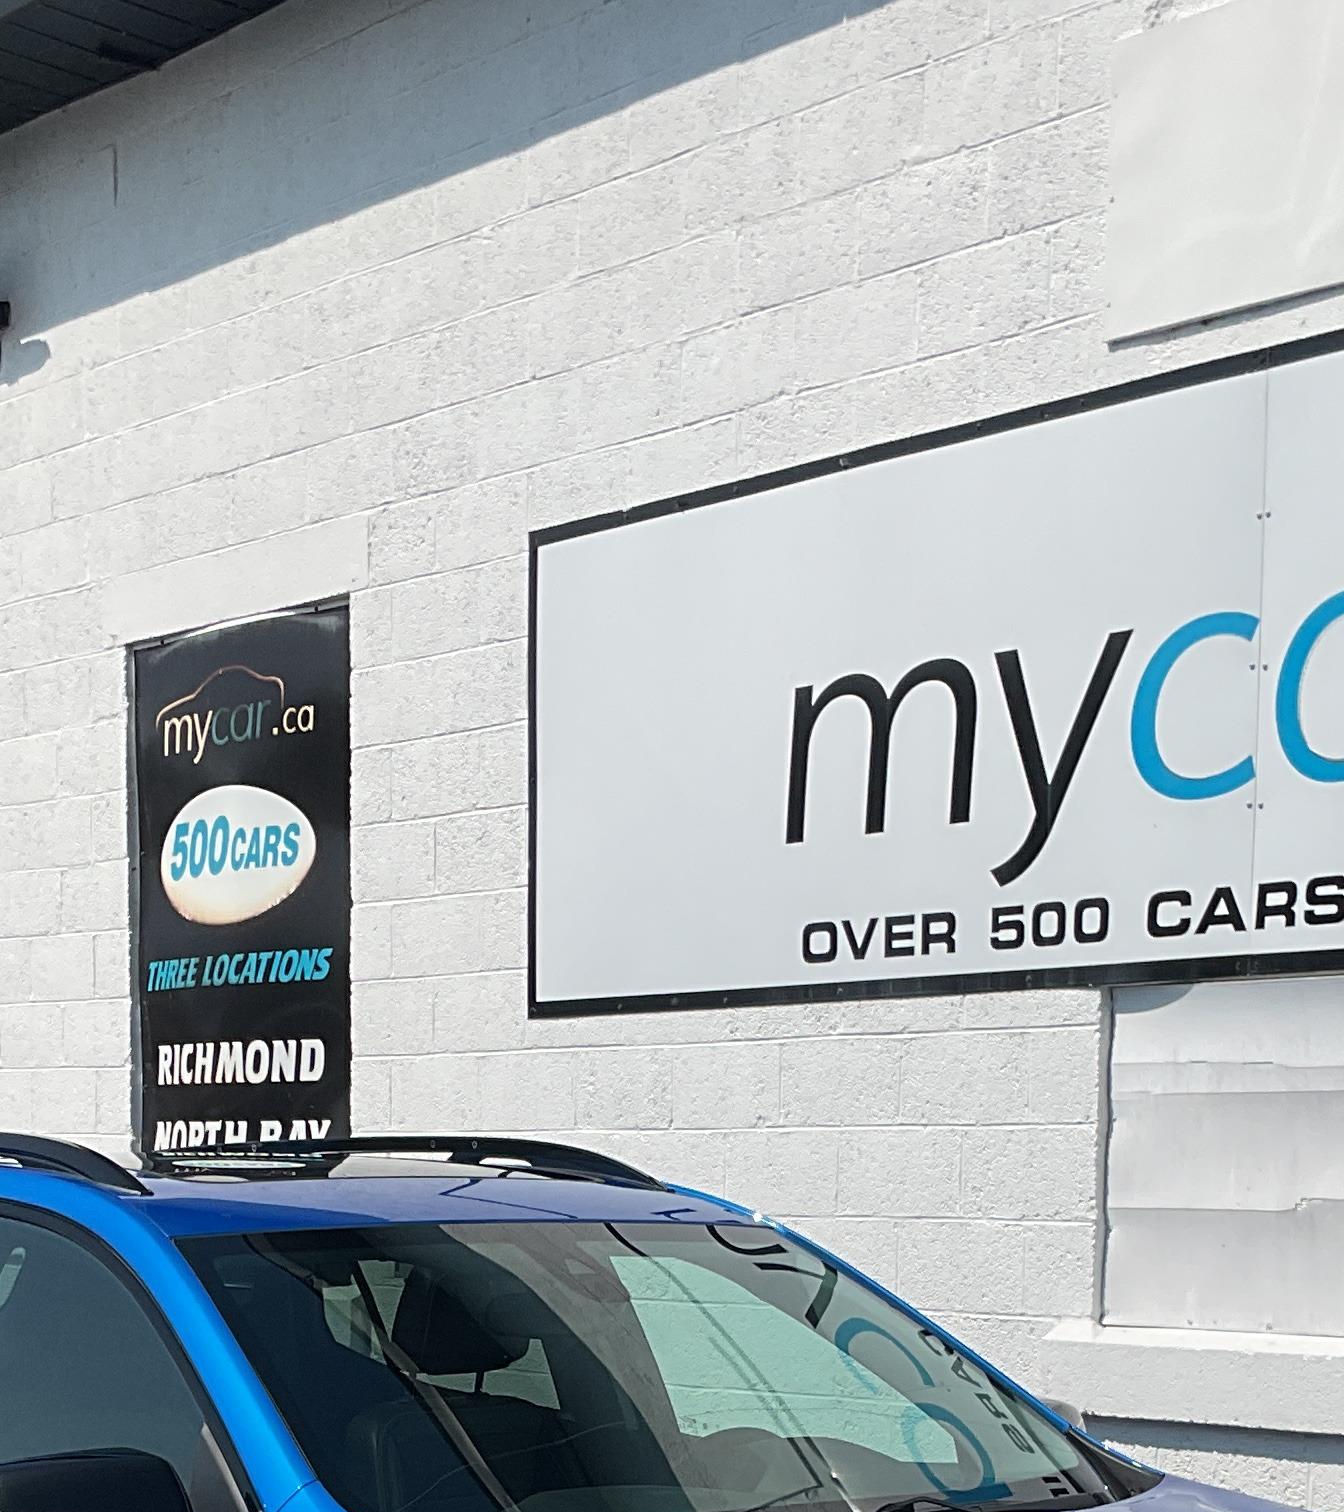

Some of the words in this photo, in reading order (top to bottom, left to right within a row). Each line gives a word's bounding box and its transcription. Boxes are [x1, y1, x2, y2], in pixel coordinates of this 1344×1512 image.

[162, 700, 315, 764] mycar.ca
[802, 911, 956, 961] OVER
[990, 897, 1110, 950] 500
[147, 957, 199, 993] THREE
[201, 948, 333, 987] LOCATIONS
[156, 1038, 326, 1086] RICHMOND
[153, 1120, 248, 1152] NORTH
